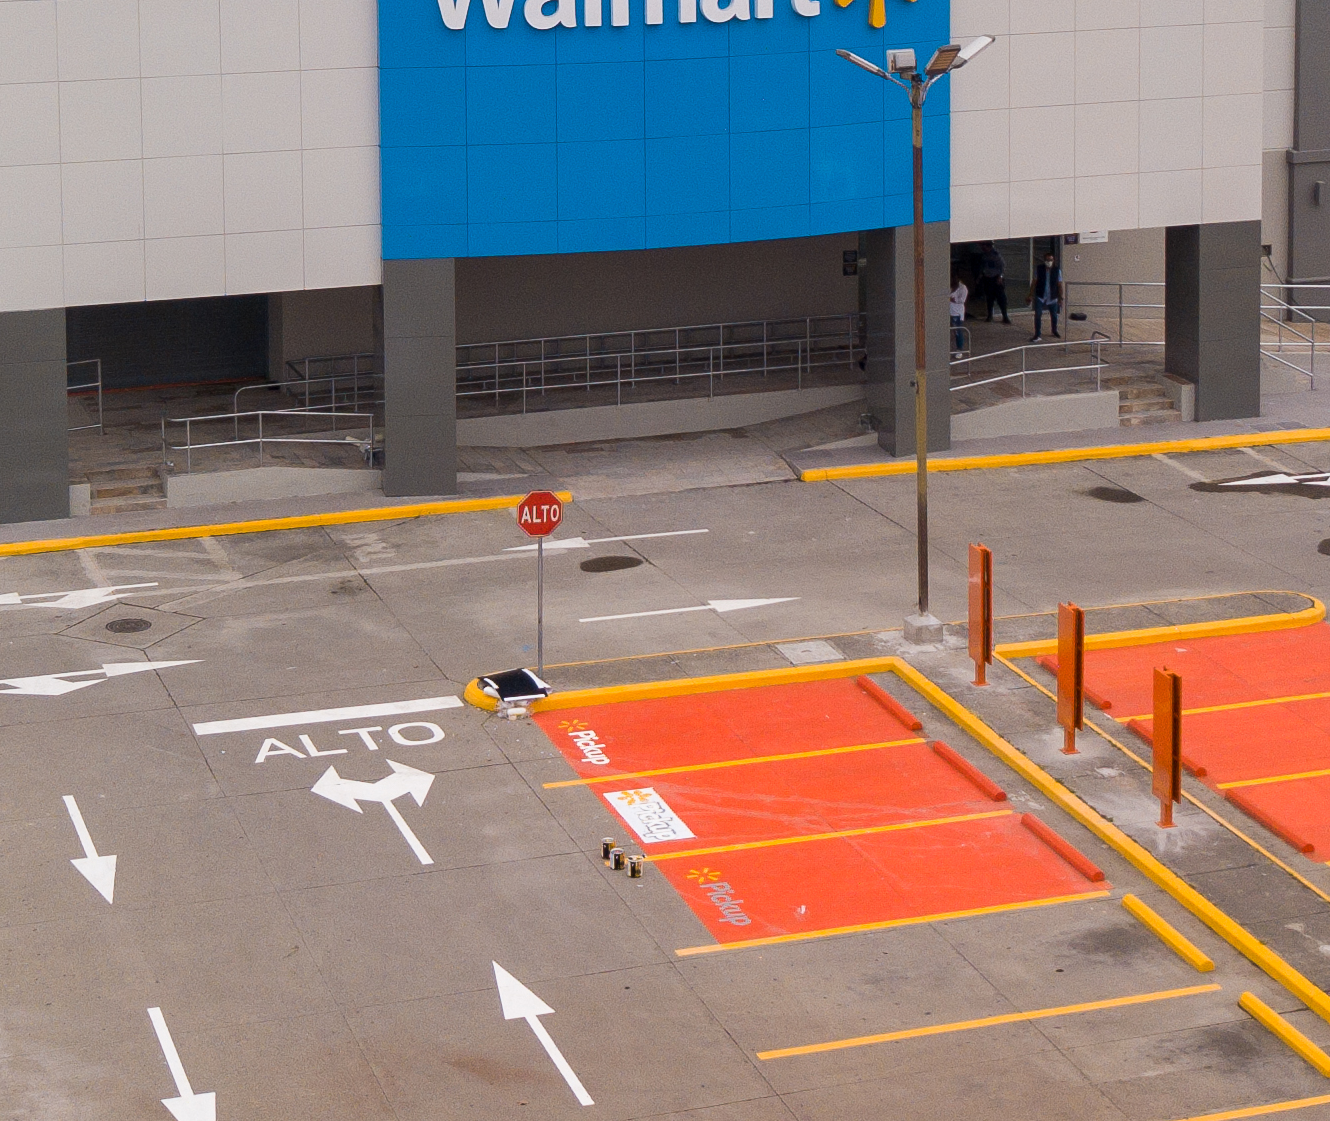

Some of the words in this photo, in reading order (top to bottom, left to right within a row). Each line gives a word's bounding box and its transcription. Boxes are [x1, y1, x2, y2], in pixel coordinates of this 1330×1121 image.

[521, 504, 560, 524] ALTO
[254, 721, 446, 764] ALTO
[568, 729, 611, 765] Pickup
[700, 881, 752, 926] Pickup
